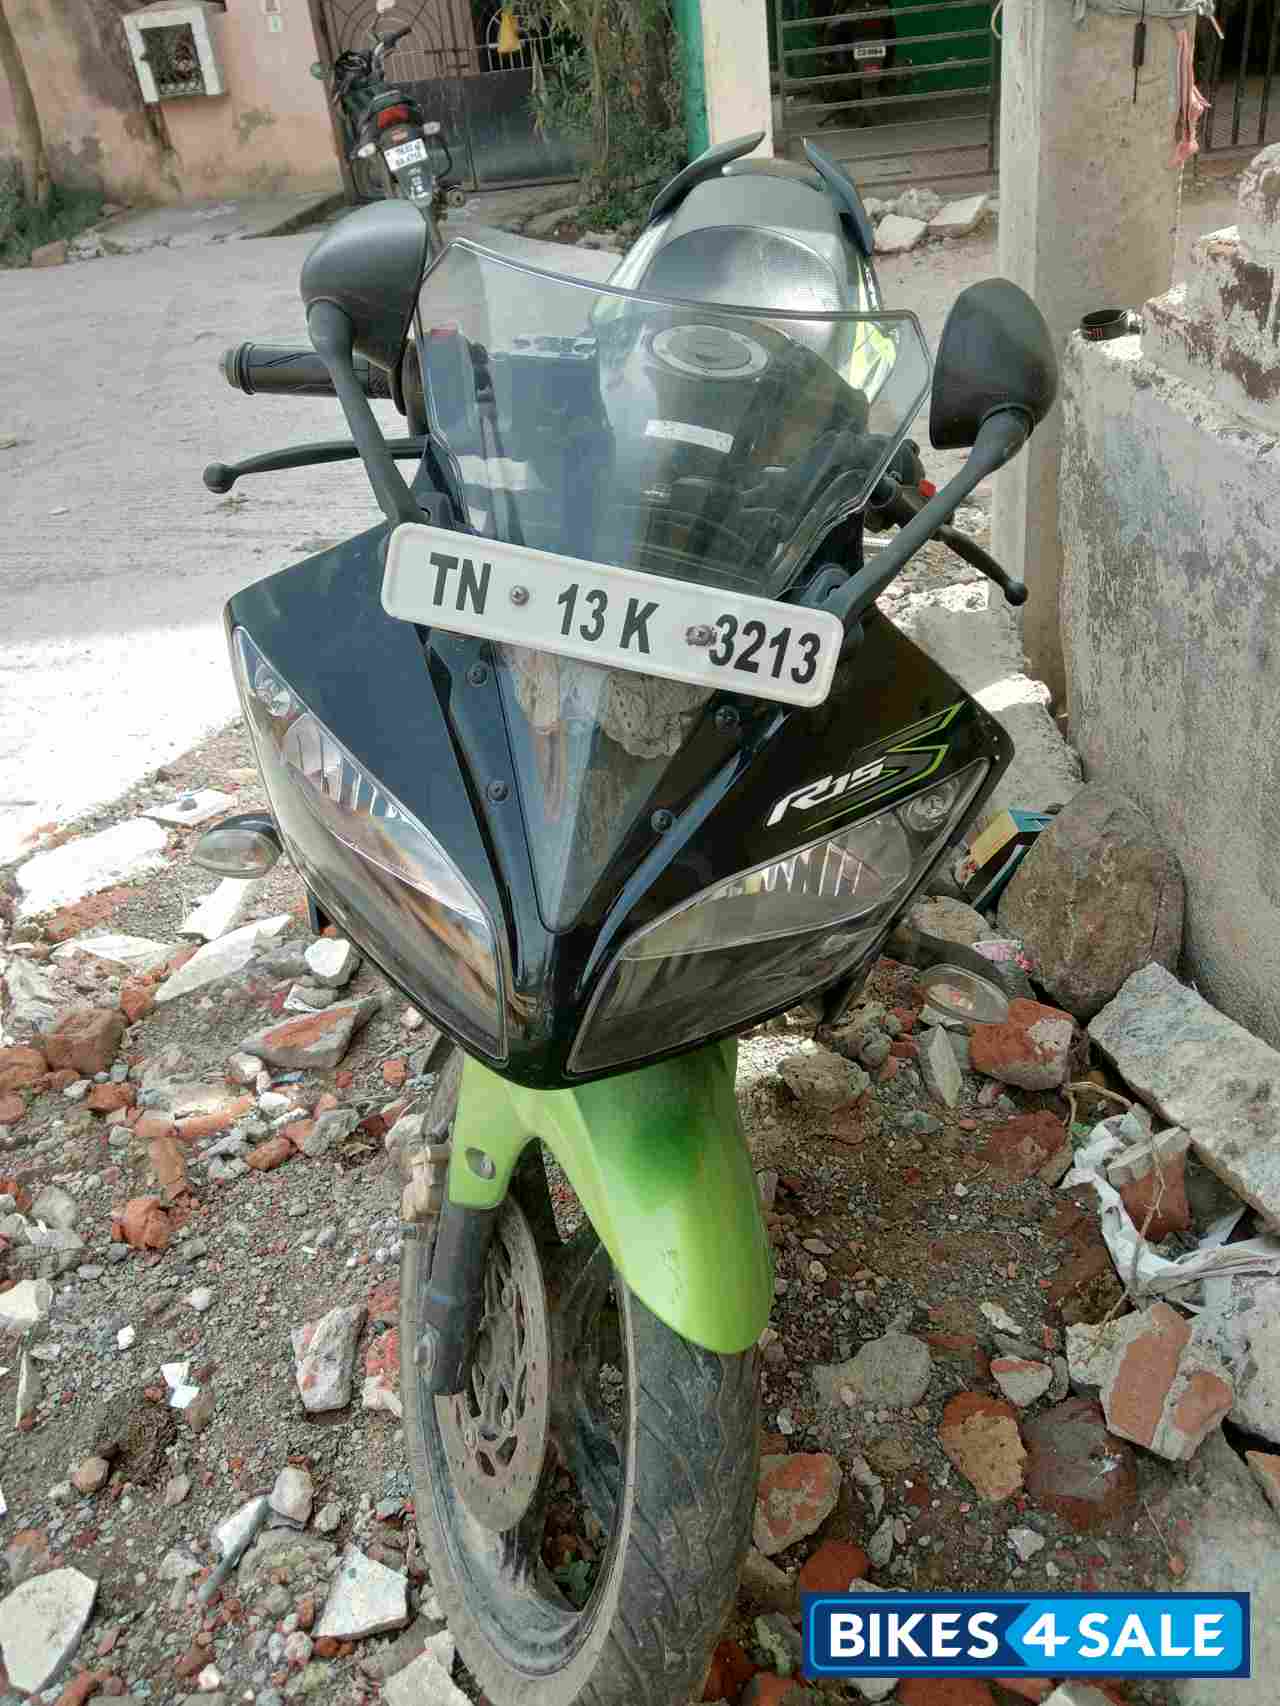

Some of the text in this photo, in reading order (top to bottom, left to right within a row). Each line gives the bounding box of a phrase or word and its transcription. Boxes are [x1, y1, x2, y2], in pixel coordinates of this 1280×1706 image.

[430, 552, 822, 685] TN 13 K 3213
